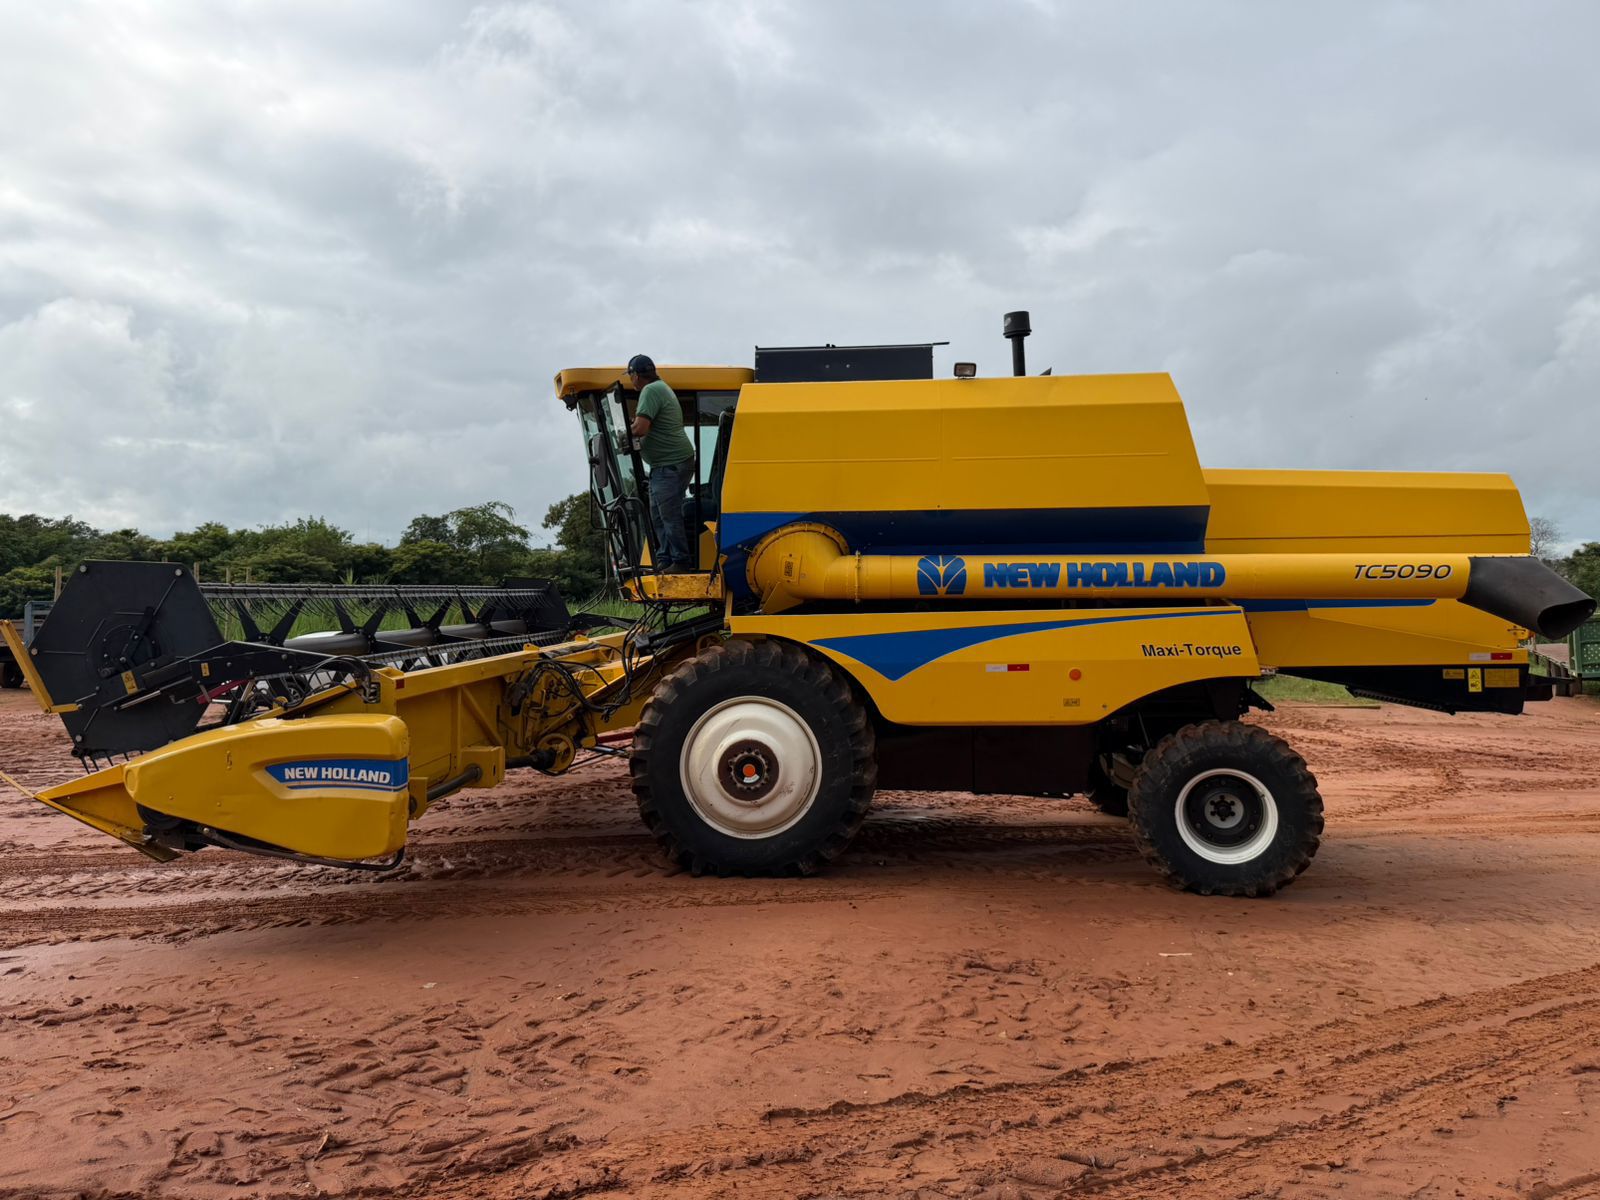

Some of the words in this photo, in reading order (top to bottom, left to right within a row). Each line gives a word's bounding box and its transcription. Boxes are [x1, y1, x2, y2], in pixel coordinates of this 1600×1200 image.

[983, 562, 1061, 588] NEW
[1067, 562, 1226, 588] HOLLAND
[1354, 564, 1452, 580] TC5090
[1141, 643, 1242, 658] Maxi-Torque
[284, 767, 318, 779] NEW
[322, 767, 390, 783] HOLLAND
